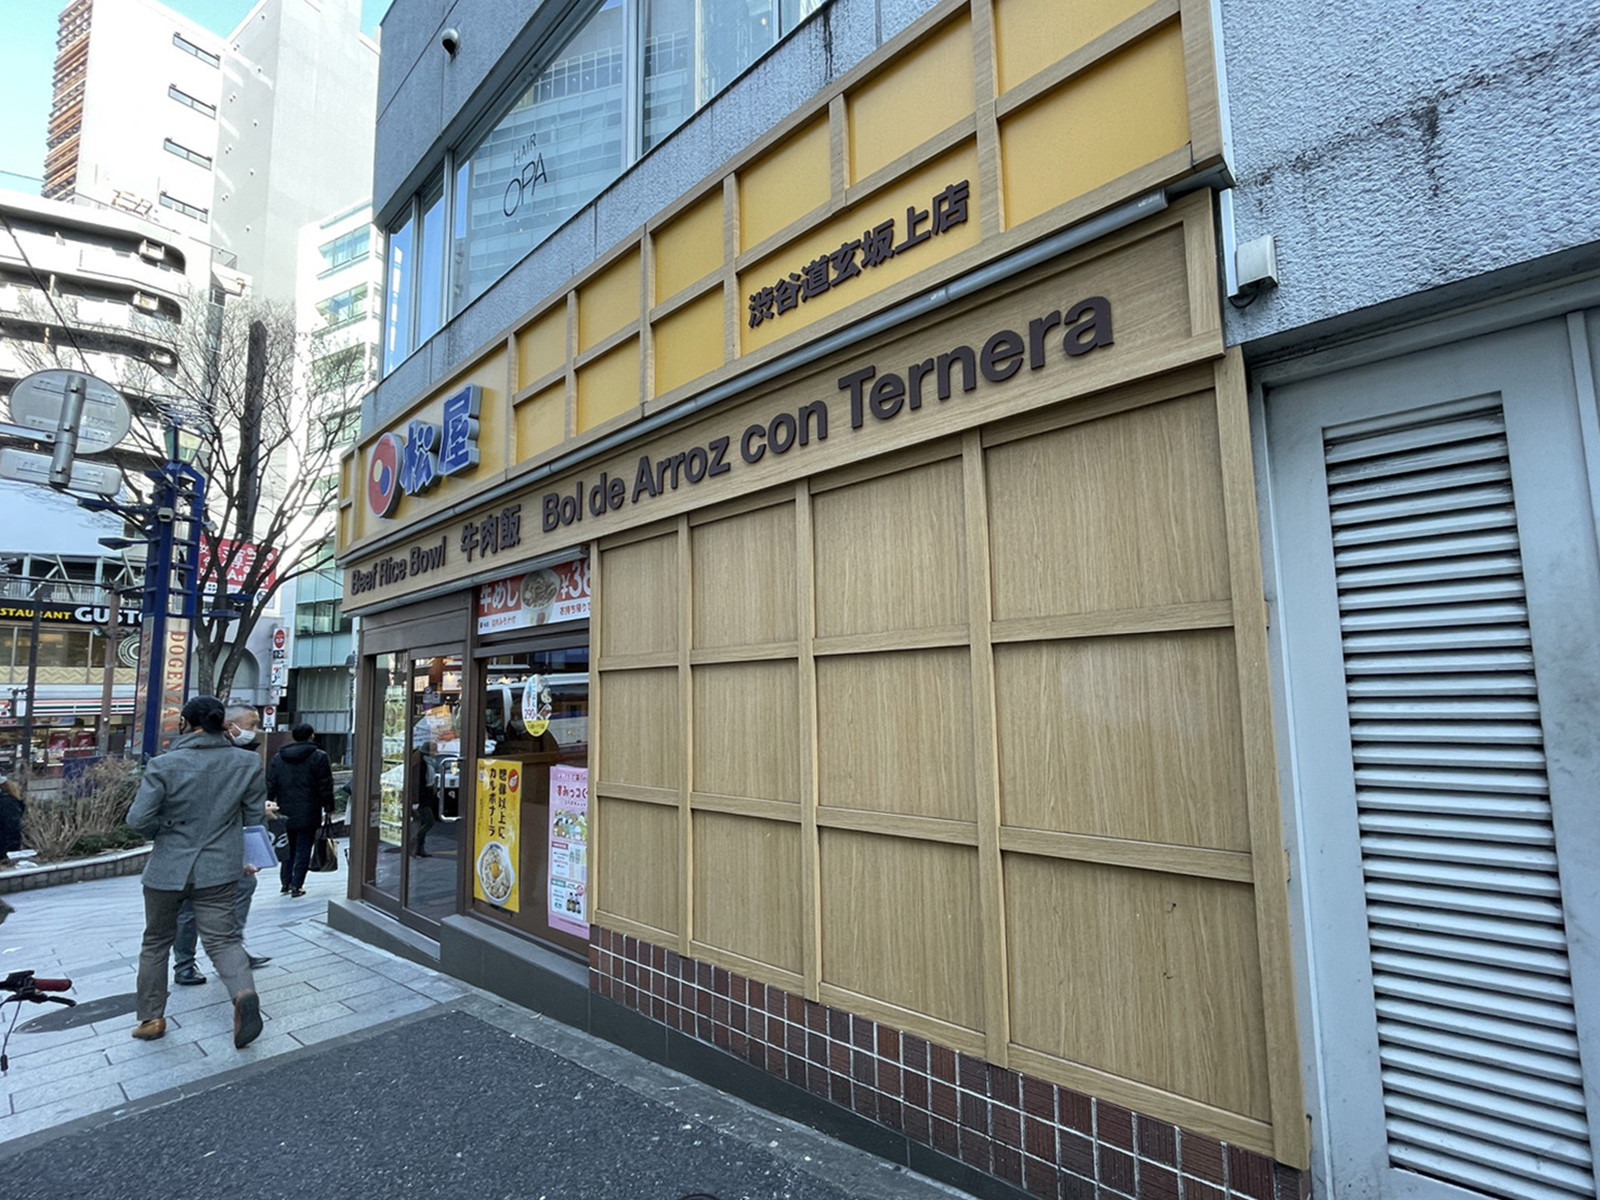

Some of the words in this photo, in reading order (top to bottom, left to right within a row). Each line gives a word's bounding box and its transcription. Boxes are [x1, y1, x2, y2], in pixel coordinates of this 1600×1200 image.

[503, 153, 548, 217] OPA
[514, 133, 538, 164] HAIR
[748, 180, 970, 329] 渋谷道玄坂上店
[351, 563, 379, 596] Beef
[379, 557, 408, 587] Rice
[409, 536, 447, 577] Bowl
[460, 504, 521, 562] 牛肉飯
[543, 481, 583, 533] Bol
[588, 472, 626, 517] de
[632, 435, 731, 503] Arroz
[740, 399, 828, 464] con
[838, 296, 1115, 429] Ternera
[400, 384, 480, 497] 松屋
[480, 580, 519, 613] 牛めし
